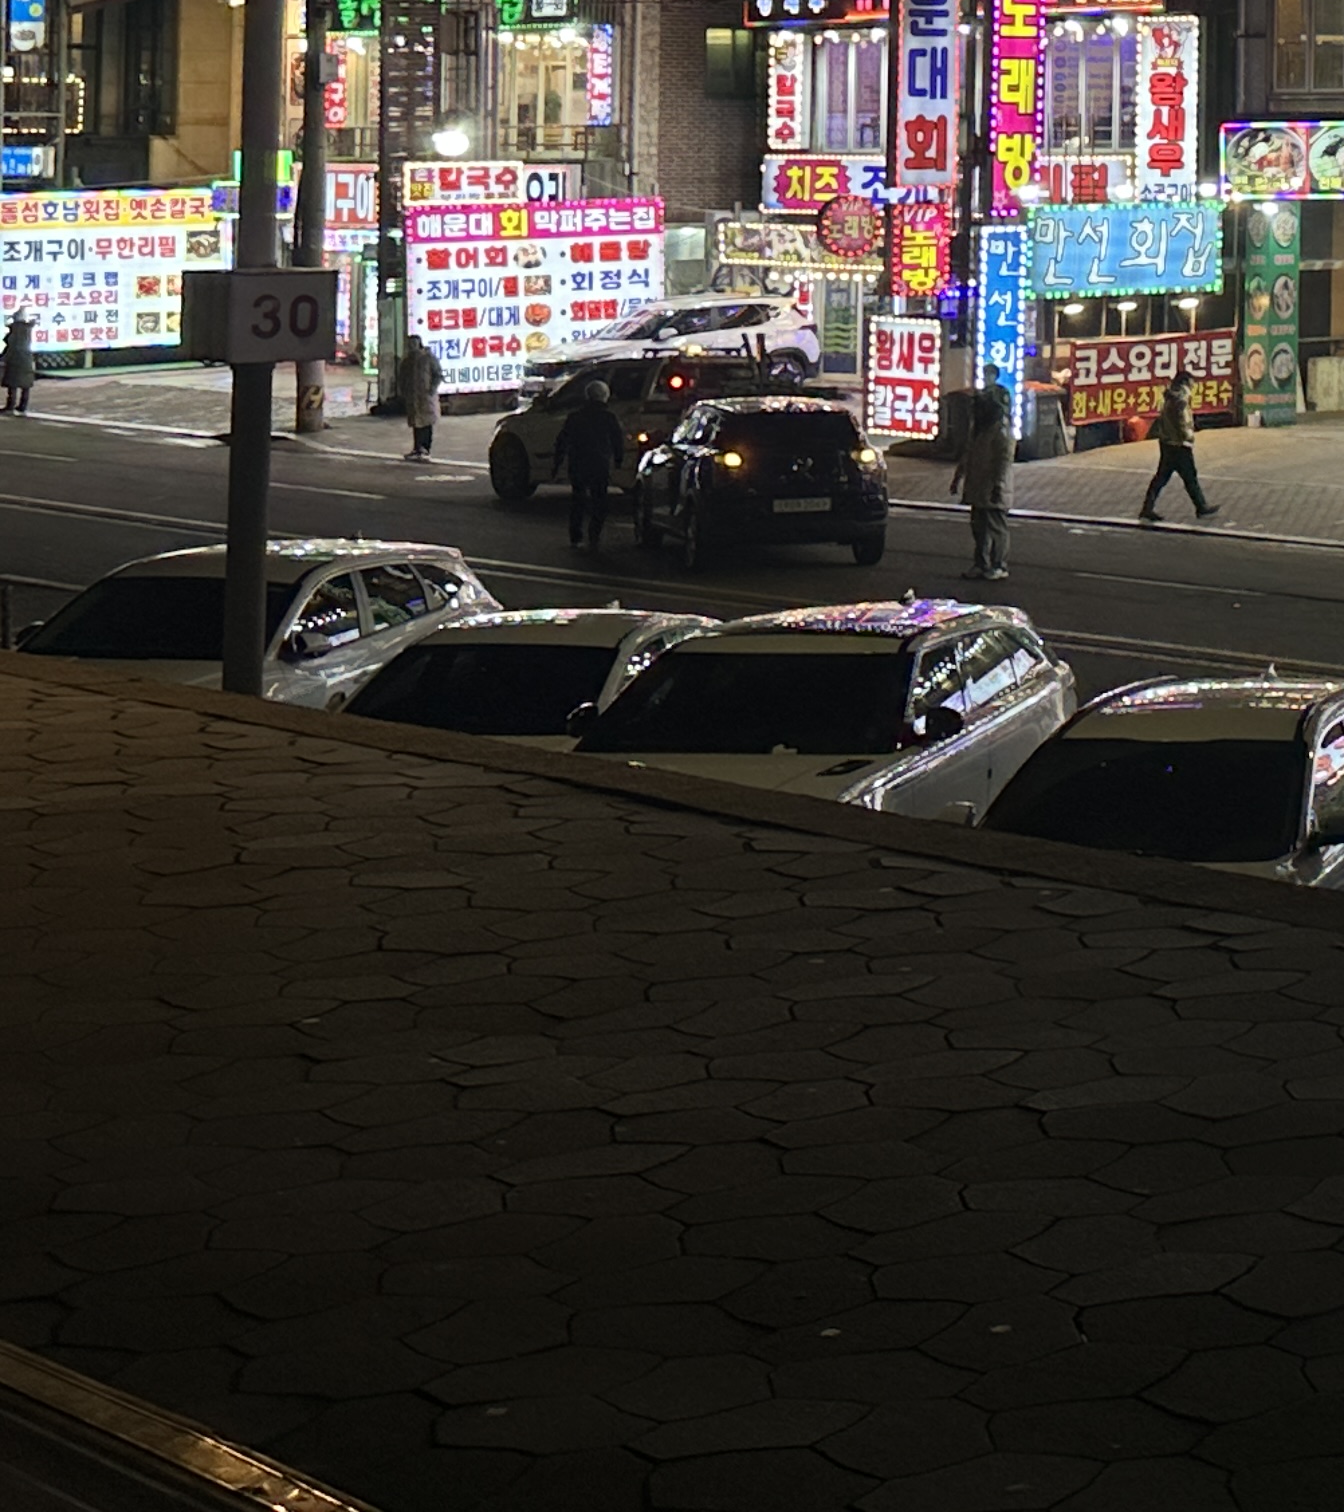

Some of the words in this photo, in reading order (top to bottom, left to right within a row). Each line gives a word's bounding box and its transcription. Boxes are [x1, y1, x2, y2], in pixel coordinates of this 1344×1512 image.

[438, 166, 518, 191] 칼국수
[785, 164, 839, 202] 치즈
[416, 213, 493, 238] 해운대
[499, 209, 529, 236] 회
[534, 206, 656, 233] 막퍼주는집
[828, 215, 874, 240] 노래방
[903, 208, 938, 223] VIP
[426, 246, 508, 270] 활어회
[902, 226, 939, 290] 노래방
[571, 268, 650, 292] 회정식
[252, 294, 319, 339] 30
[877, 329, 937, 373] 왕새우
[1073, 343, 1178, 386] 코스요리
[1182, 338, 1234, 378] 전문
[874, 385, 937, 427] 칼국수
